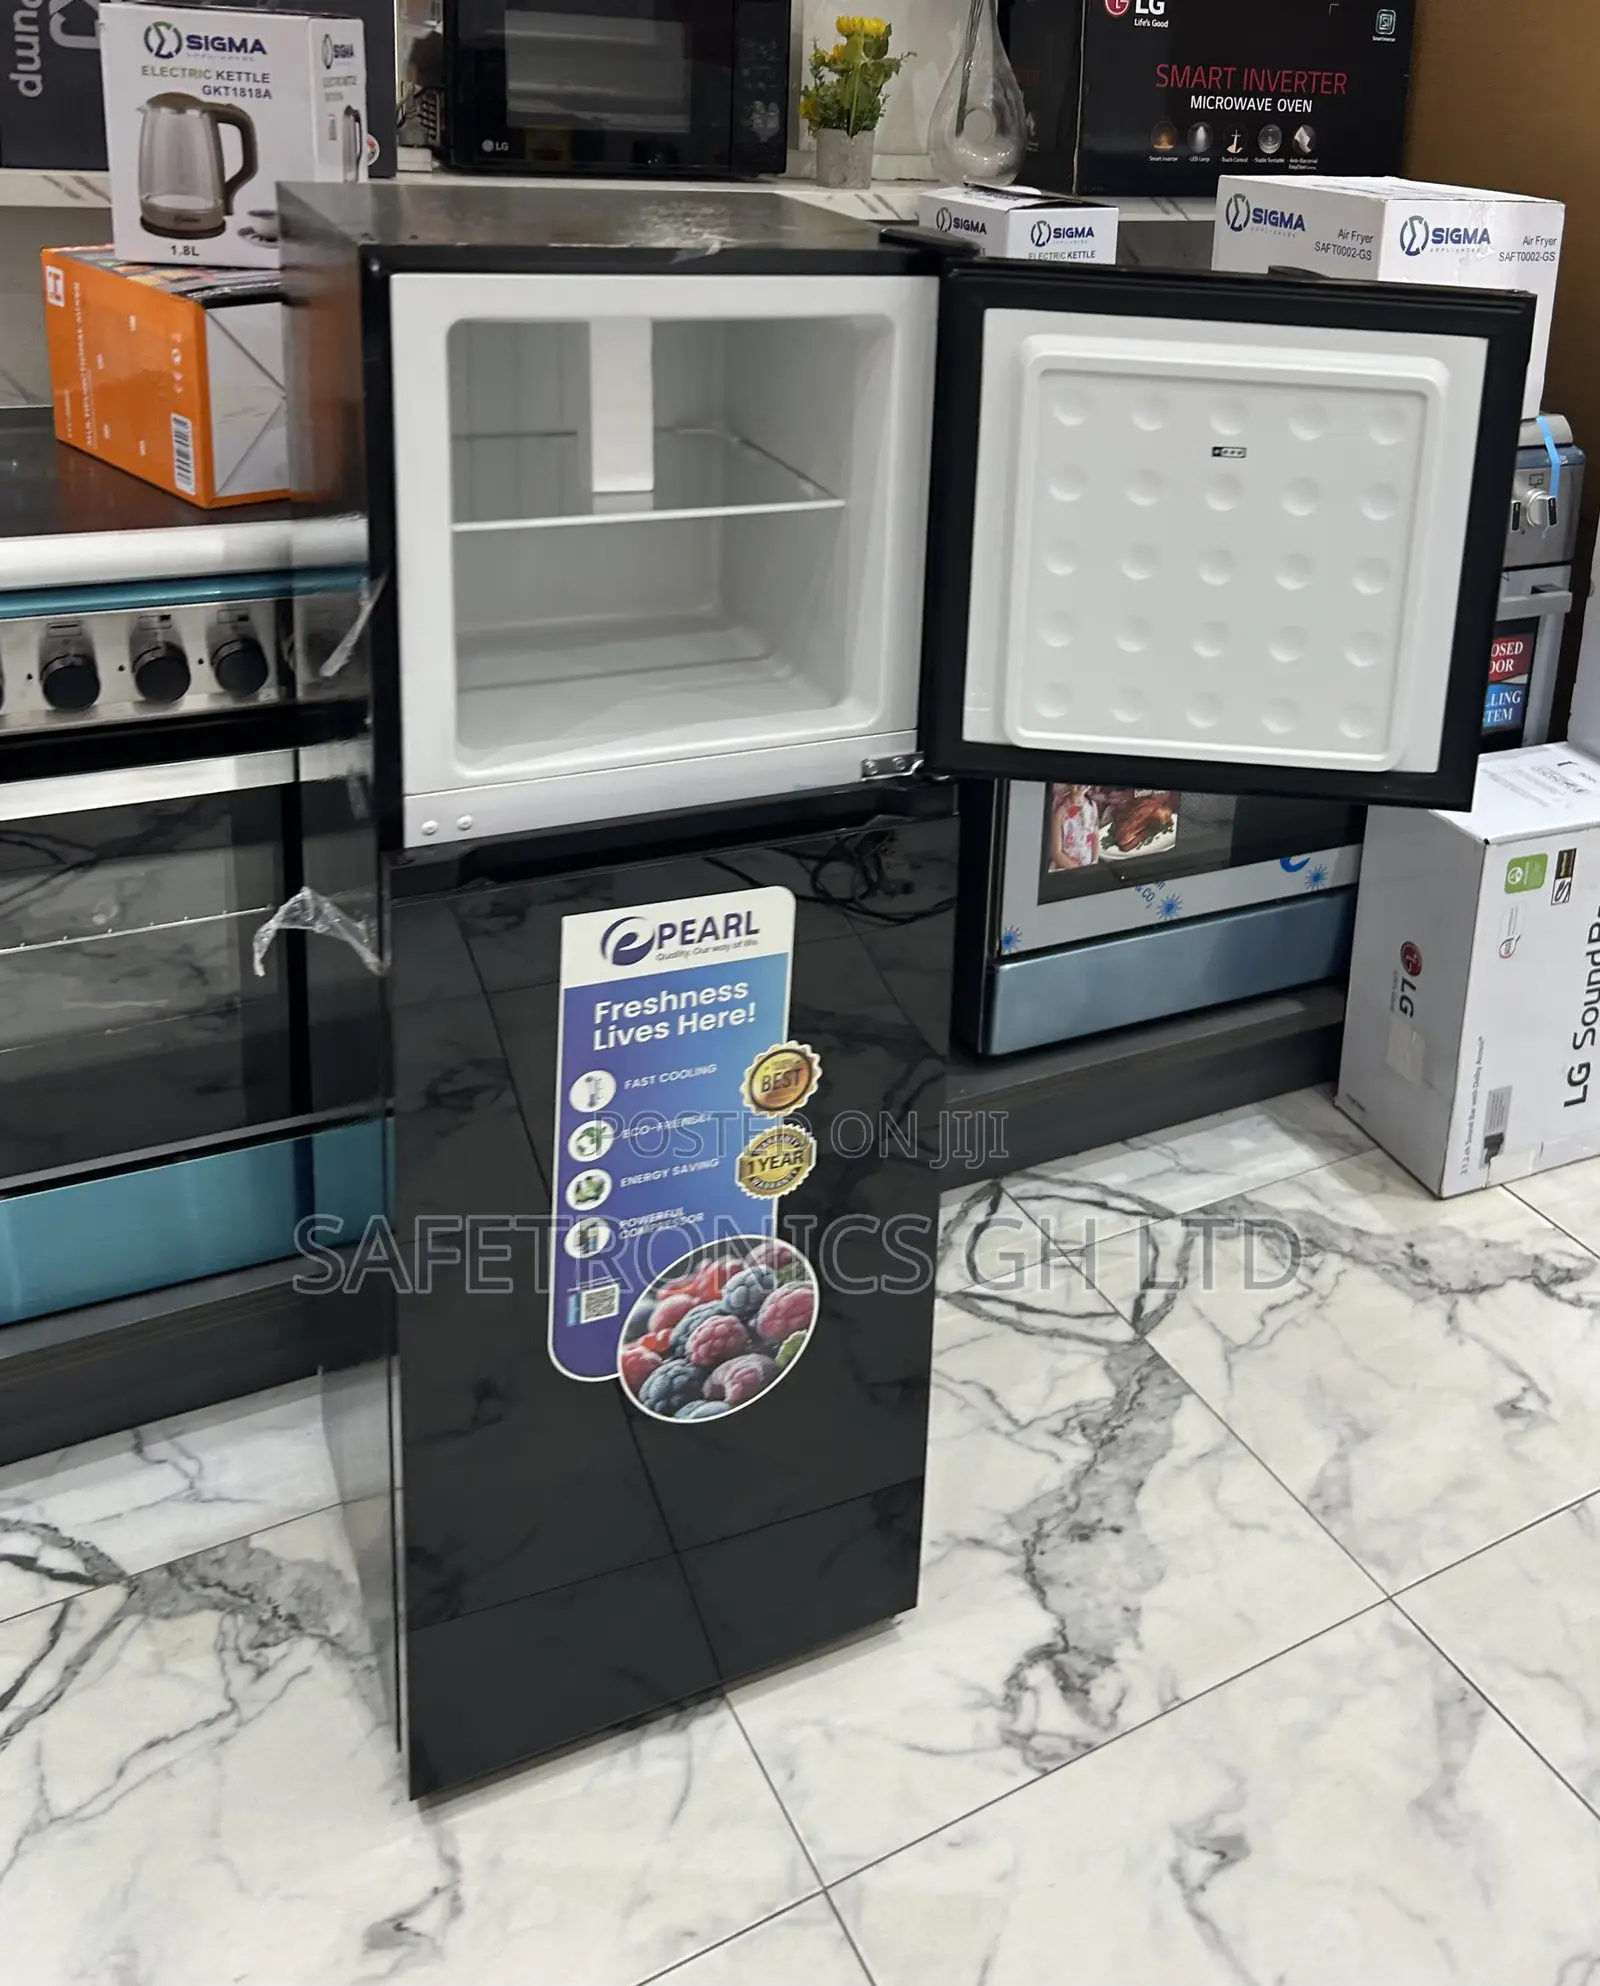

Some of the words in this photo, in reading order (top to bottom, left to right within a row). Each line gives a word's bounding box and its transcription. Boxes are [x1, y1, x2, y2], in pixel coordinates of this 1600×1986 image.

[1135, 0, 1165, 15] LG
[1134, 18, 1151, 27] Life's
[1151, 19, 1169, 28] Good
[185, 34, 267, 55] SIGMA
[141, 64, 212, 80] ELECTRIC
[216, 70, 270, 84] KETTLE
[1155, 63, 1237, 90] SMART
[1242, 67, 1348, 95] INVERTER
[201, 85, 272, 100] GKT1818A
[1190, 95, 1273, 112] MICROWAVE
[1277, 98, 1313, 113] OVEN
[495, 140, 509, 151] LG
[953, 217, 987, 235] SIGMA
[1251, 207, 1306, 232] SIGMA
[1052, 226, 1095, 239] SIGMA
[1337, 228, 1350, 241] Air
[1350, 230, 1374, 245] Fryer
[1431, 227, 1491, 245] SIGMA
[1522, 236, 1534, 247] Air
[1535, 236, 1558, 249] Fryer
[170, 244, 200, 257] 1.8L
[1028, 252, 1066, 261] ELECTRIC
[1067, 250, 1096, 260] KETTLE
[1314, 241, 1373, 262] SAFT0002-GS
[1498, 251, 1556, 263] SAFT0002-GS
[1491, 641, 1524, 658] OSED
[656, 910, 761, 950] PEARL
[594, 981, 749, 1025] Freshness
[1400, 976, 1416, 1019] LG
[1571, 951, 1600, 1051] Sound
[592, 1020, 672, 1051] Lives
[676, 1001, 757, 1036] Here!
[623, 1075, 657, 1090] FAST
[659, 1063, 718, 1083] COOLING
[761, 1067, 803, 1093] BEST
[1563, 1061, 1591, 1108] LG
[759, 1149, 804, 1172] YEAR
[620, 1168, 670, 1188] ENERGY
[671, 1157, 720, 1176] SAVING
[619, 1206, 684, 1230] POWERFUL
